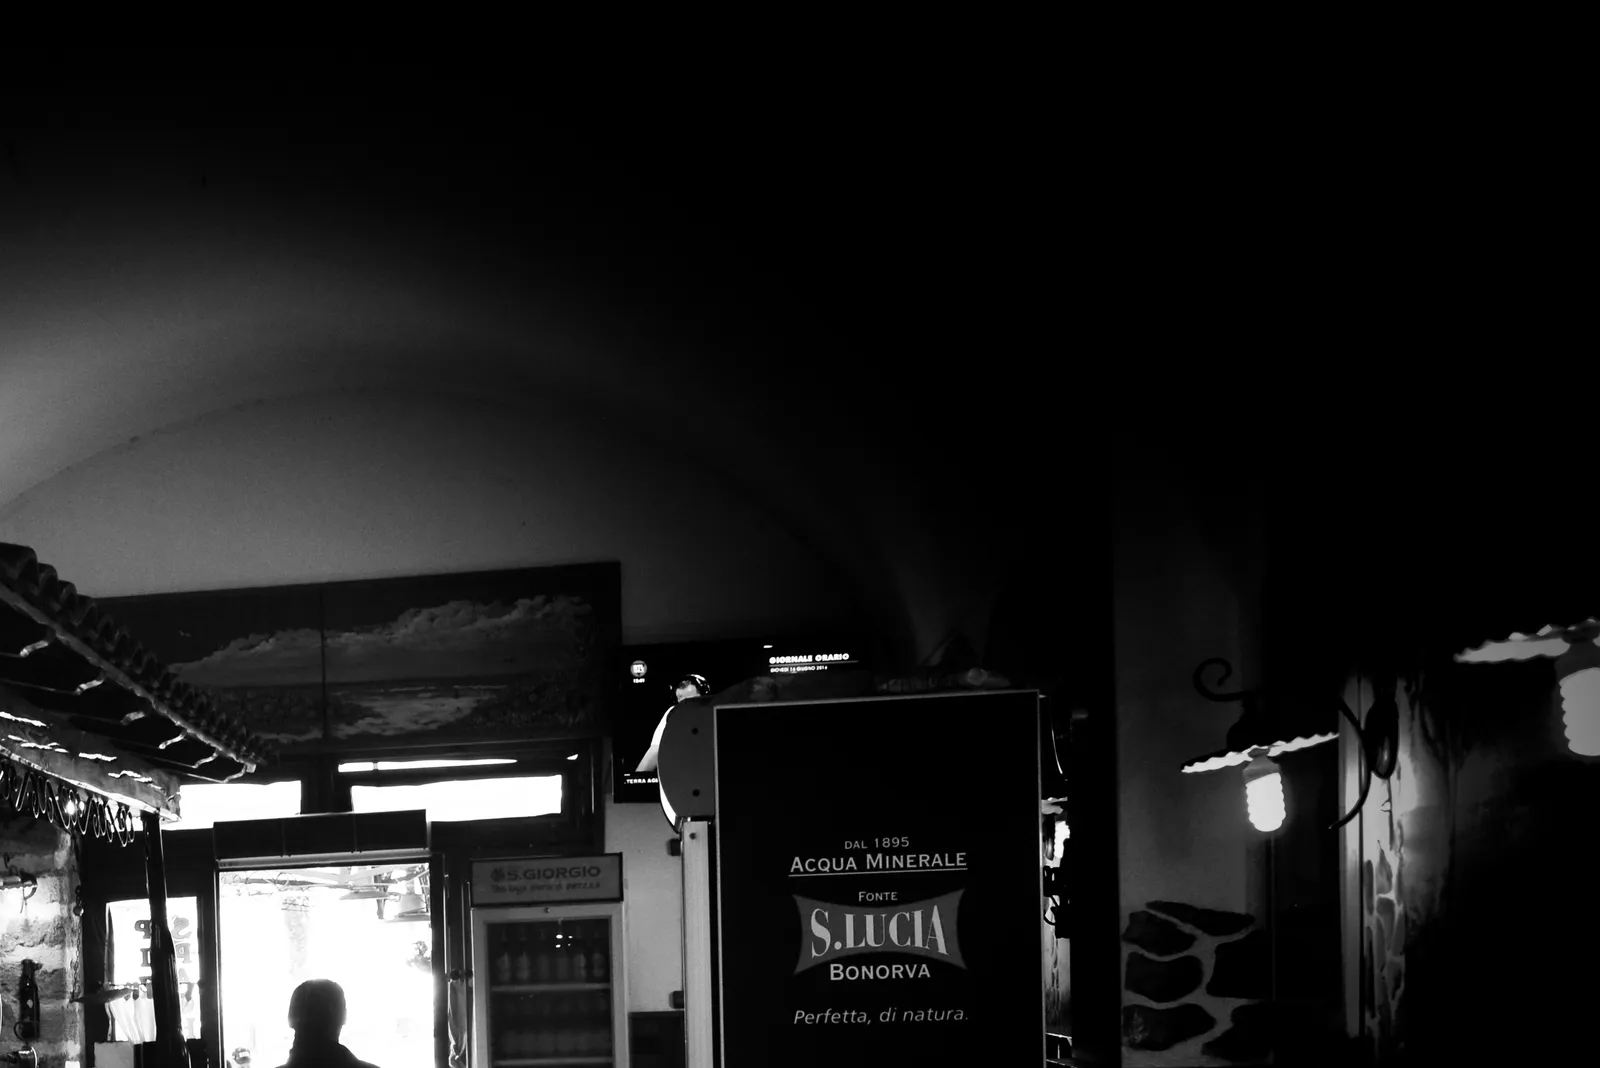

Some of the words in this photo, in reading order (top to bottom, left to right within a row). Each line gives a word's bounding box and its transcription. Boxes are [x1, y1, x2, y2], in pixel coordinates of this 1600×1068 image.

[769, 655, 813, 664] GIORNALE
[815, 653, 850, 662] ORARIO
[844, 840, 868, 850] DAL
[875, 837, 910, 849] 1895
[790, 856, 858, 873] ACQUA
[866, 852, 968, 869] MINERALE
[858, 891, 899, 902] FONTE
[810, 904, 949, 959] S.LUCIA
[829, 963, 931, 981] BONORVA
[794, 1008, 872, 1025] Perfetta,
[879, 1007, 898, 1022] di
[903, 1008, 969, 1022] natura.
